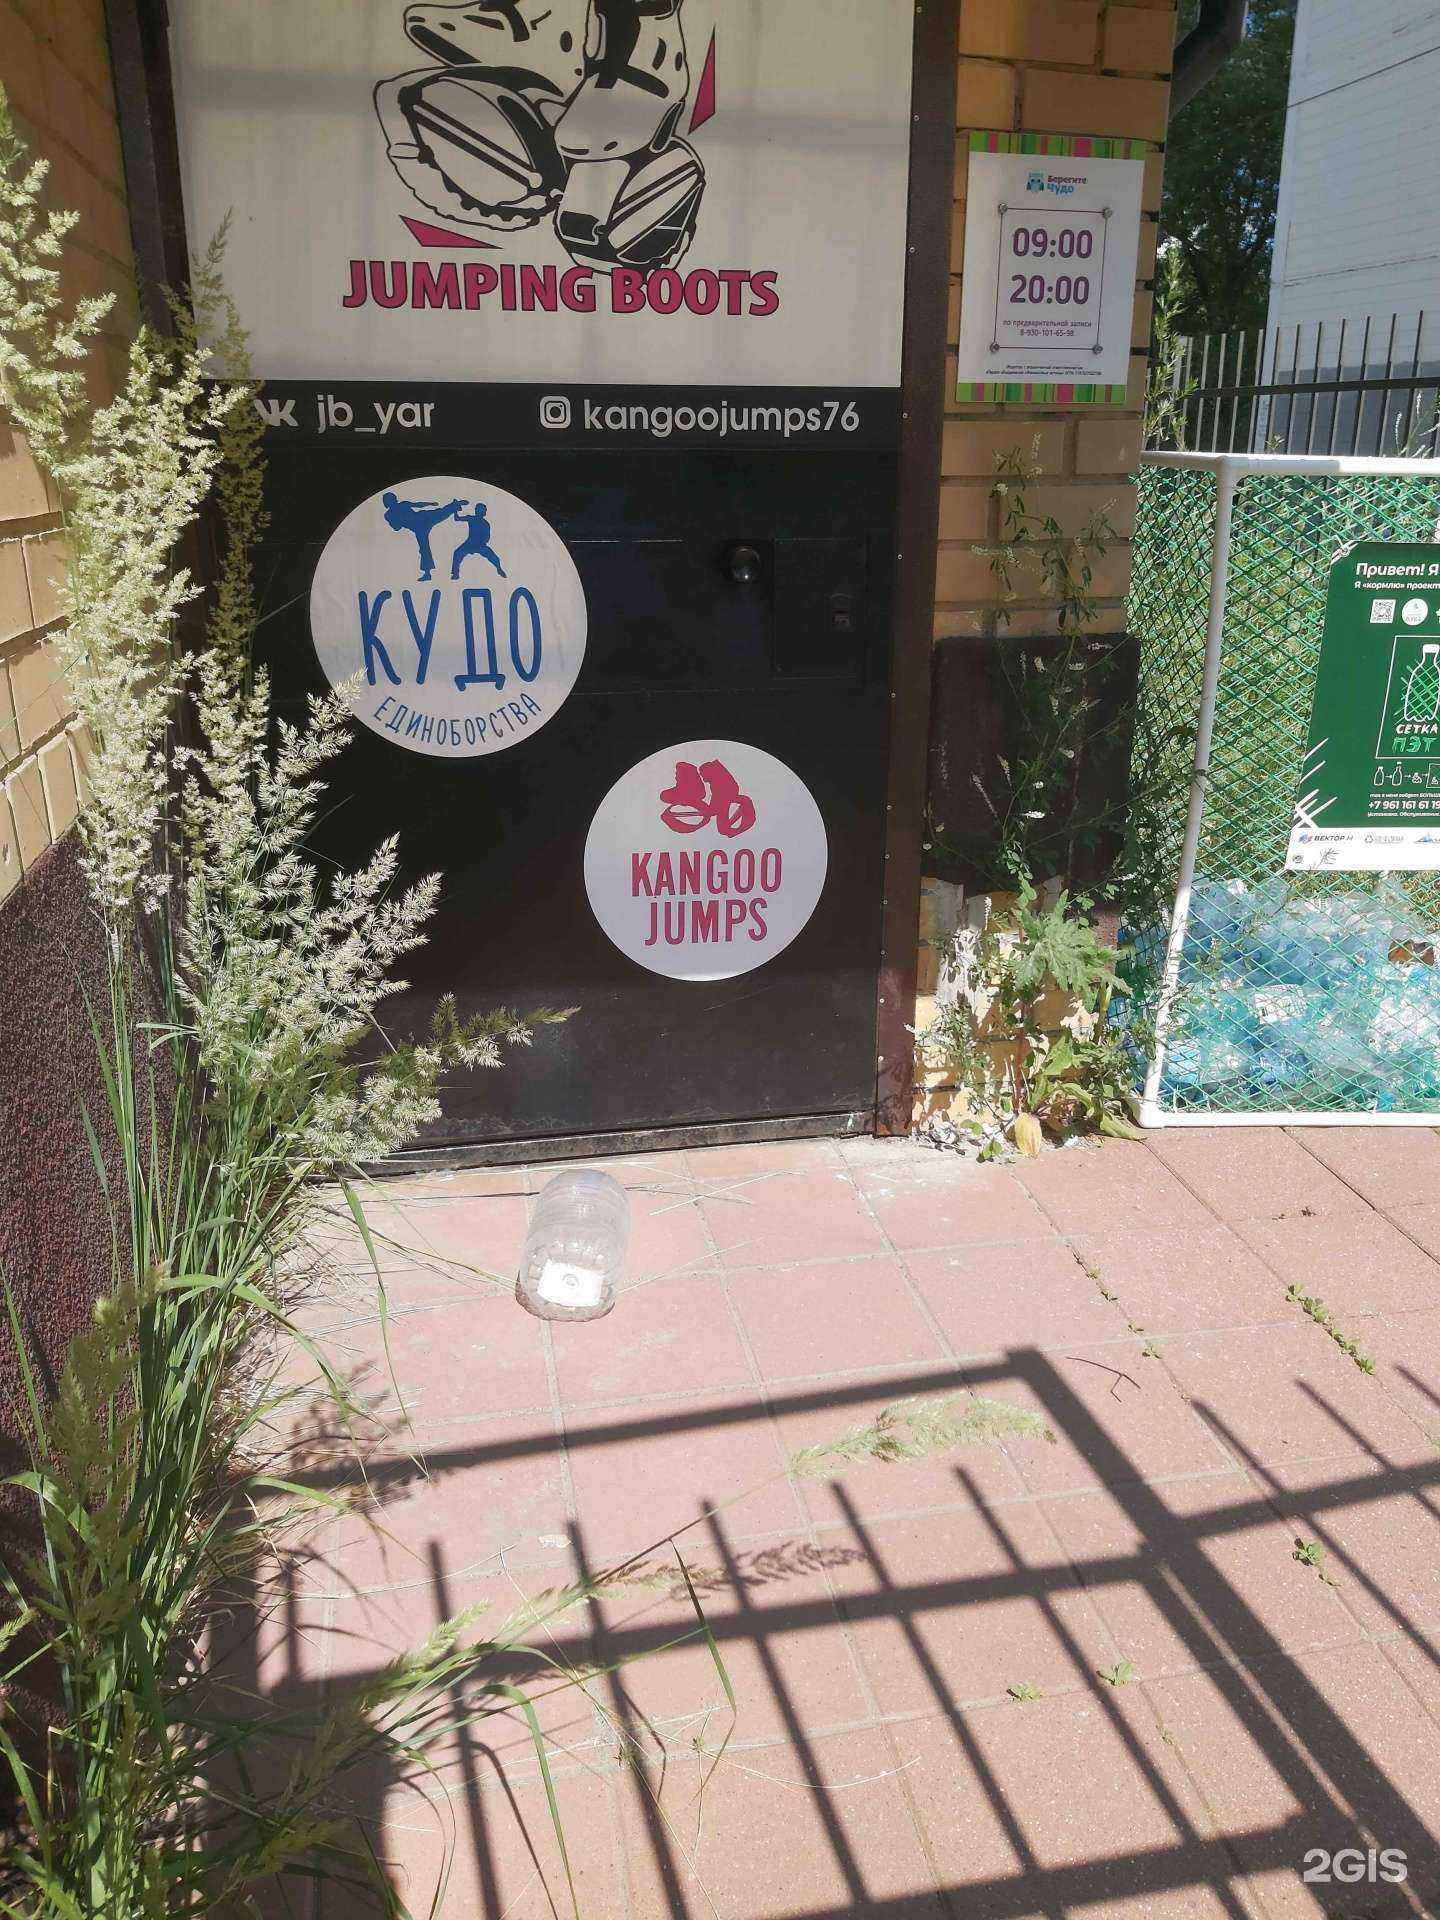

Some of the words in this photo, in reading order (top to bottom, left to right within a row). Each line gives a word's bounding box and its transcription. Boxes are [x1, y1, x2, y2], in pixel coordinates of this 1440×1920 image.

[1047, 175, 1087, 184] Берегите
[1047, 182, 1075, 195] Чудо
[1013, 228, 1093, 259] 09:00
[343, 260, 597, 313] JUMPING
[611, 268, 780, 316] BOOTS
[1010, 274, 1090, 305] 20:00
[1013, 320, 1068, 328] предварительной
[317, 394, 435, 434] jb_yar
[584, 399, 860, 438] kangoojumps76
[1354, 581, 1361, 589] Я
[1363, 582, 1405, 590] «кормлю»
[1356, 562, 1426, 578] Привет!
[1428, 563, 1440, 576] Я
[358, 586, 542, 691] КУДО
[373, 692, 542, 746] ЕДИНОБОРСТВА
[1396, 723, 1438, 735] СЕТКА
[1392, 736, 1437, 753] ПЭТ
[1368, 800, 1381, 810] +7
[1382, 800, 1400, 810] 961
[1402, 800, 1417, 810] 161
[1418, 800, 1430, 810] 61
[631, 848, 783, 897] KANGOO
[644, 897, 769, 946] JUMPS
